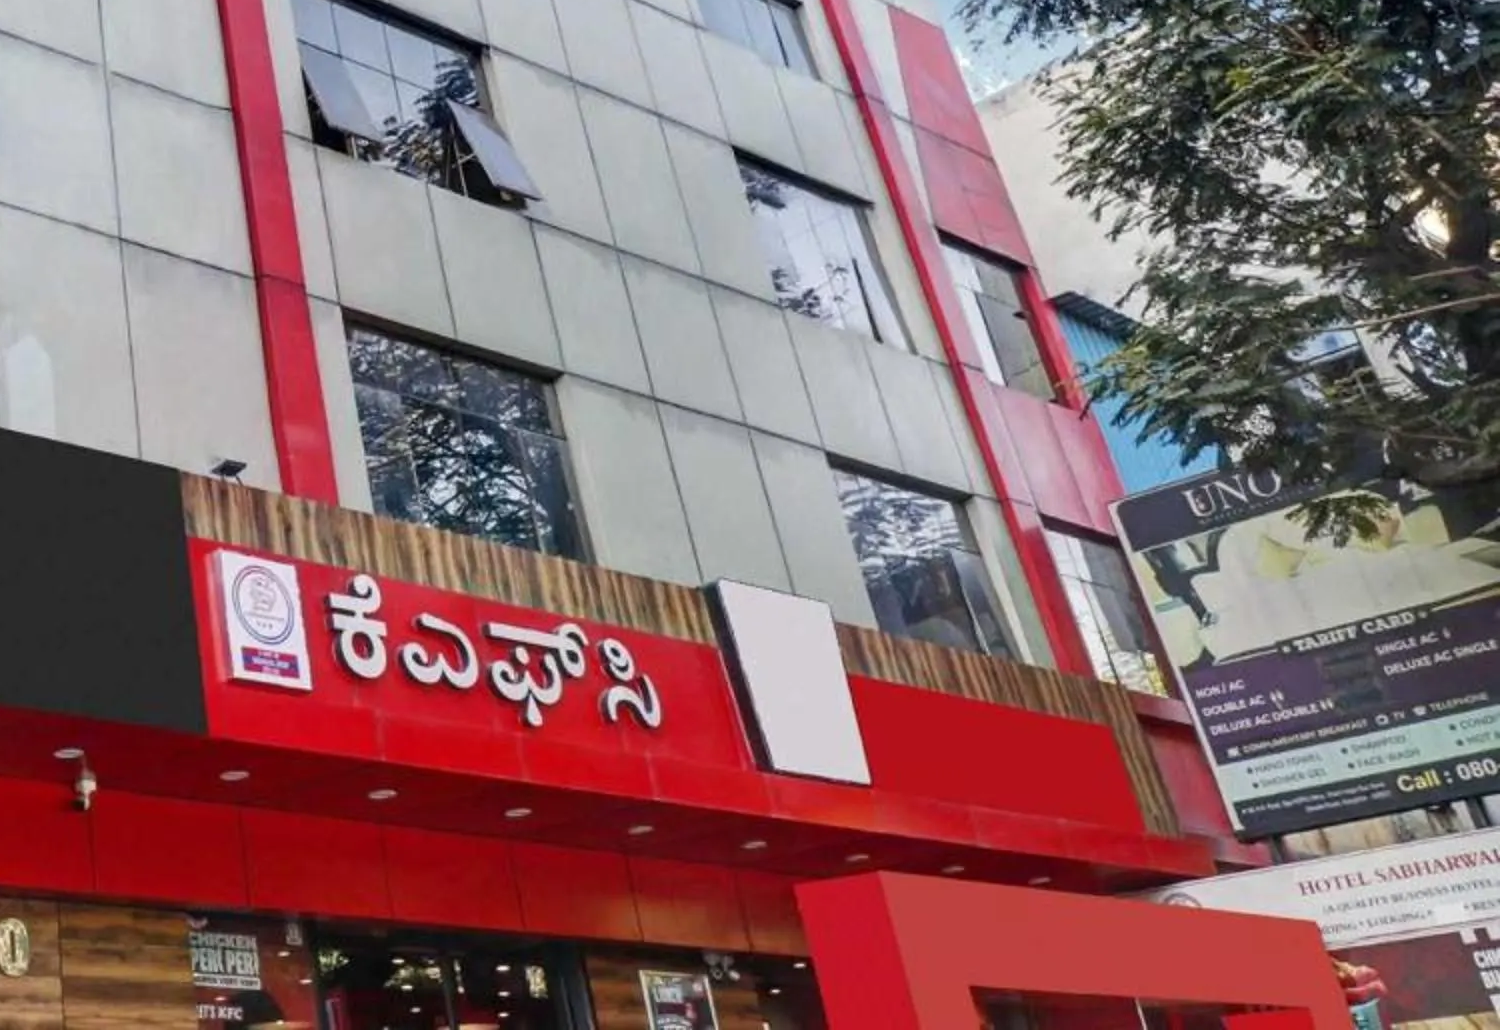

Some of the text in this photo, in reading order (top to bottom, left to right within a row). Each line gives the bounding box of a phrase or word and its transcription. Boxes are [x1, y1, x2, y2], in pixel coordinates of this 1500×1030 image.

[1181, 469, 1282, 517] UNO
[1292, 611, 1416, 652] TARIFF CARD
[1374, 631, 1439, 656] SINGLE AC
[1383, 639, 1499, 676] DELUXE AC SINGLE
[1229, 679, 1245, 692] AC
[1202, 694, 1266, 717] DOUBLE AC
[1428, 691, 1489, 712] TELEPHONE
[1209, 702, 1320, 737] DELUXE AC DOUBLE
[1397, 768, 1442, 793] Call
[1298, 872, 1372, 897] HOTEL
[1338, 895, 1389, 912] QUALITY
[1390, 886, 1450, 904] BUSINESS
[1451, 879, 1492, 894] HOTEL
[217, 1005, 245, 1021] KFC
